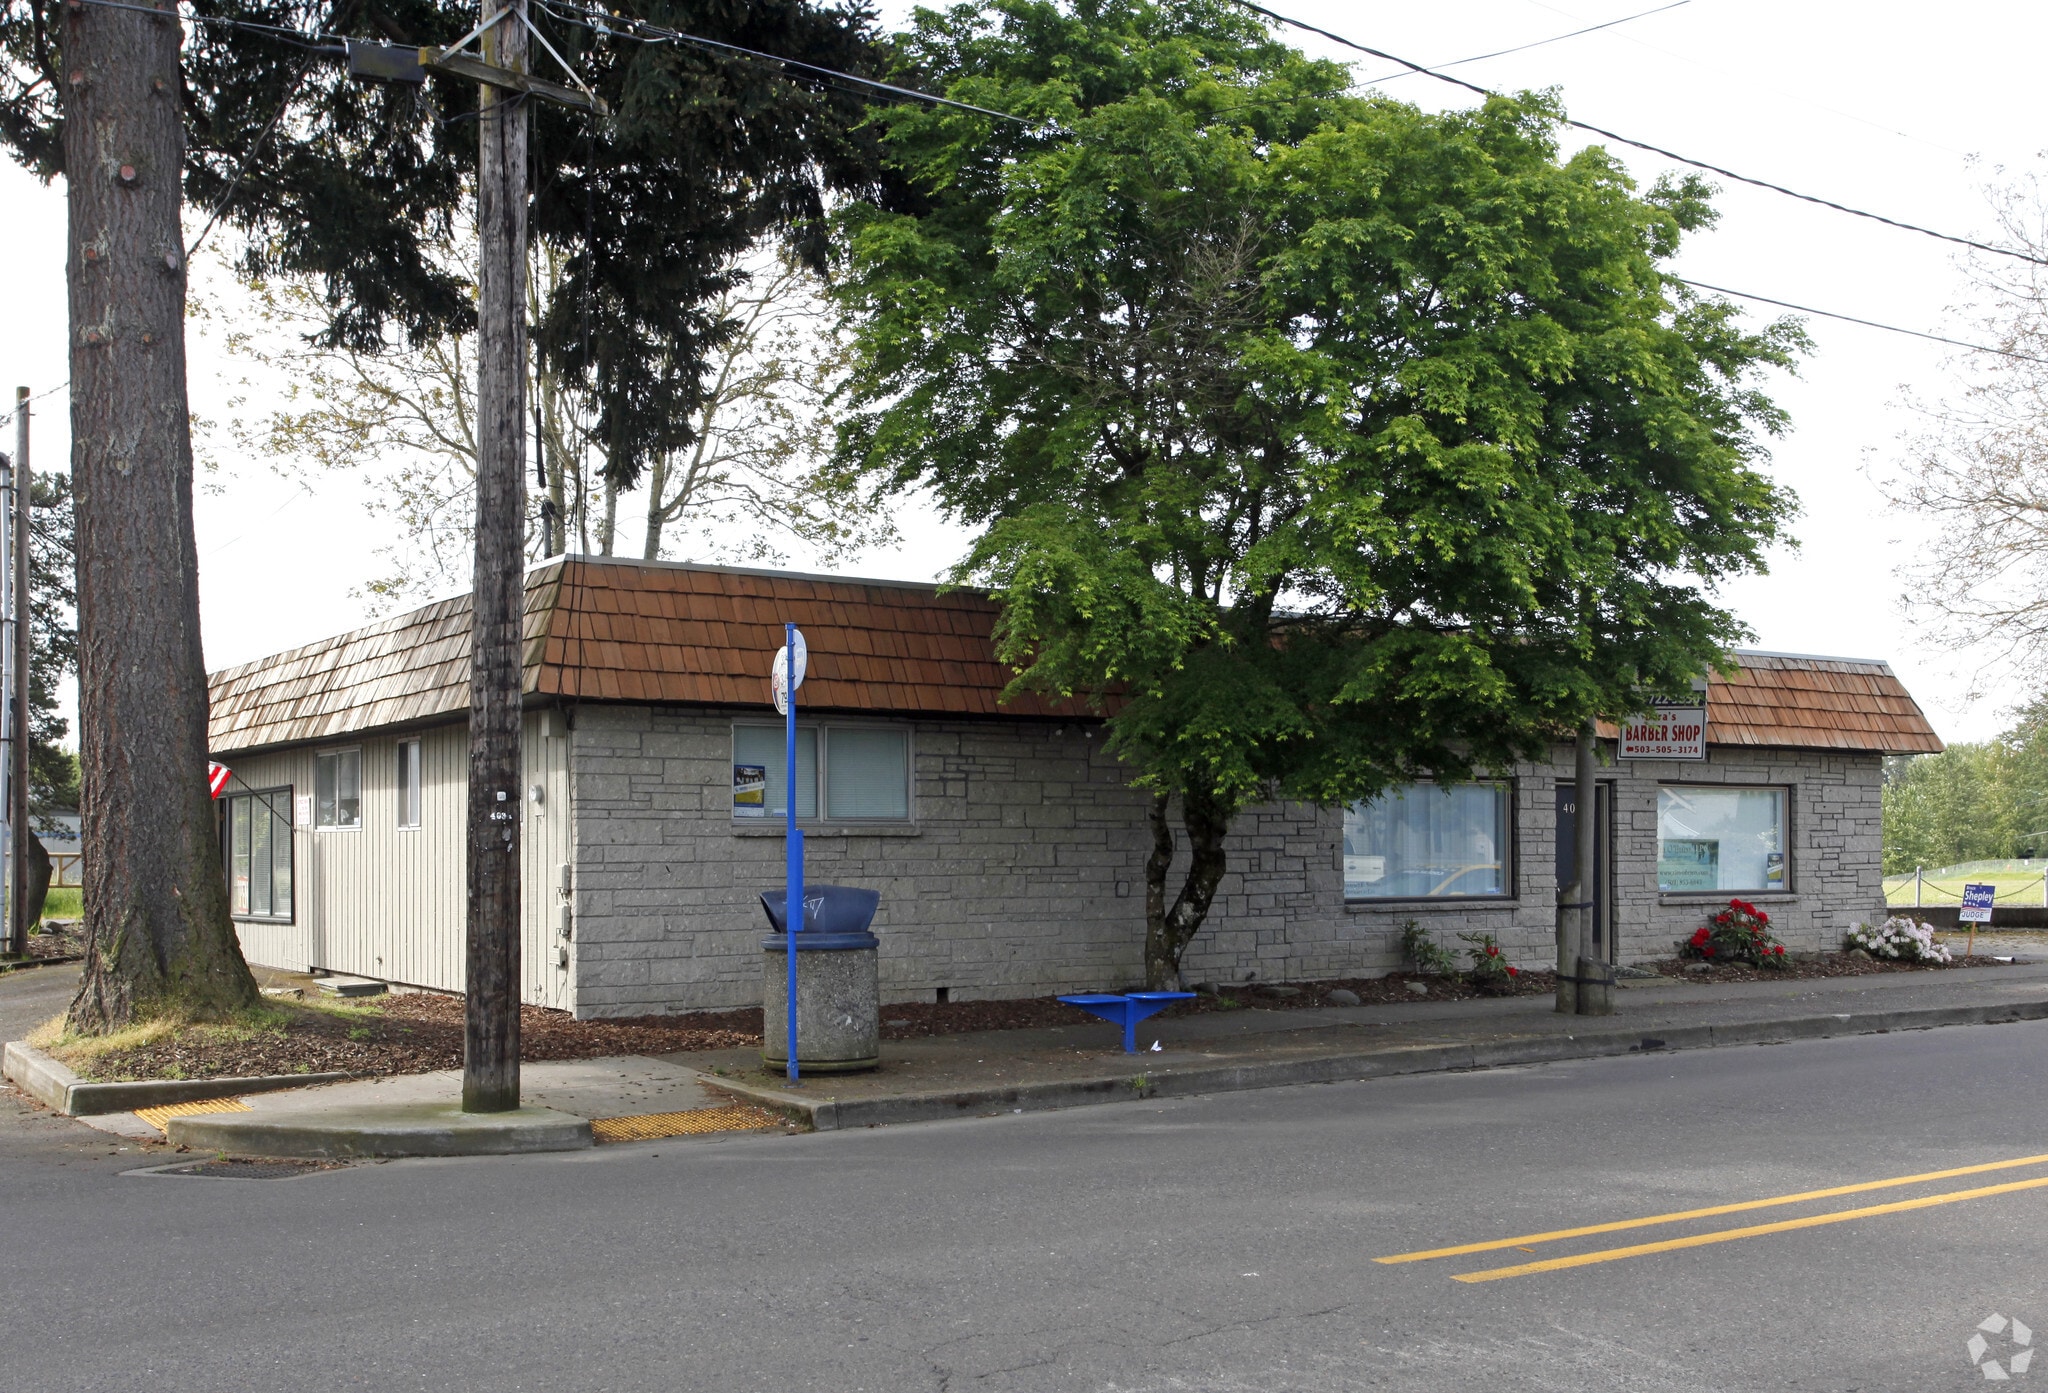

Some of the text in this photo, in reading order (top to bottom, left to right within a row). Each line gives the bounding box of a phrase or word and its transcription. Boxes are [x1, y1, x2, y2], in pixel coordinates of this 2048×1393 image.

[1626, 725, 1700, 742] BARBER SHOP
[1634, 745, 1699, 754] 503-505-3174
[1965, 891, 1993, 903] Shepley
